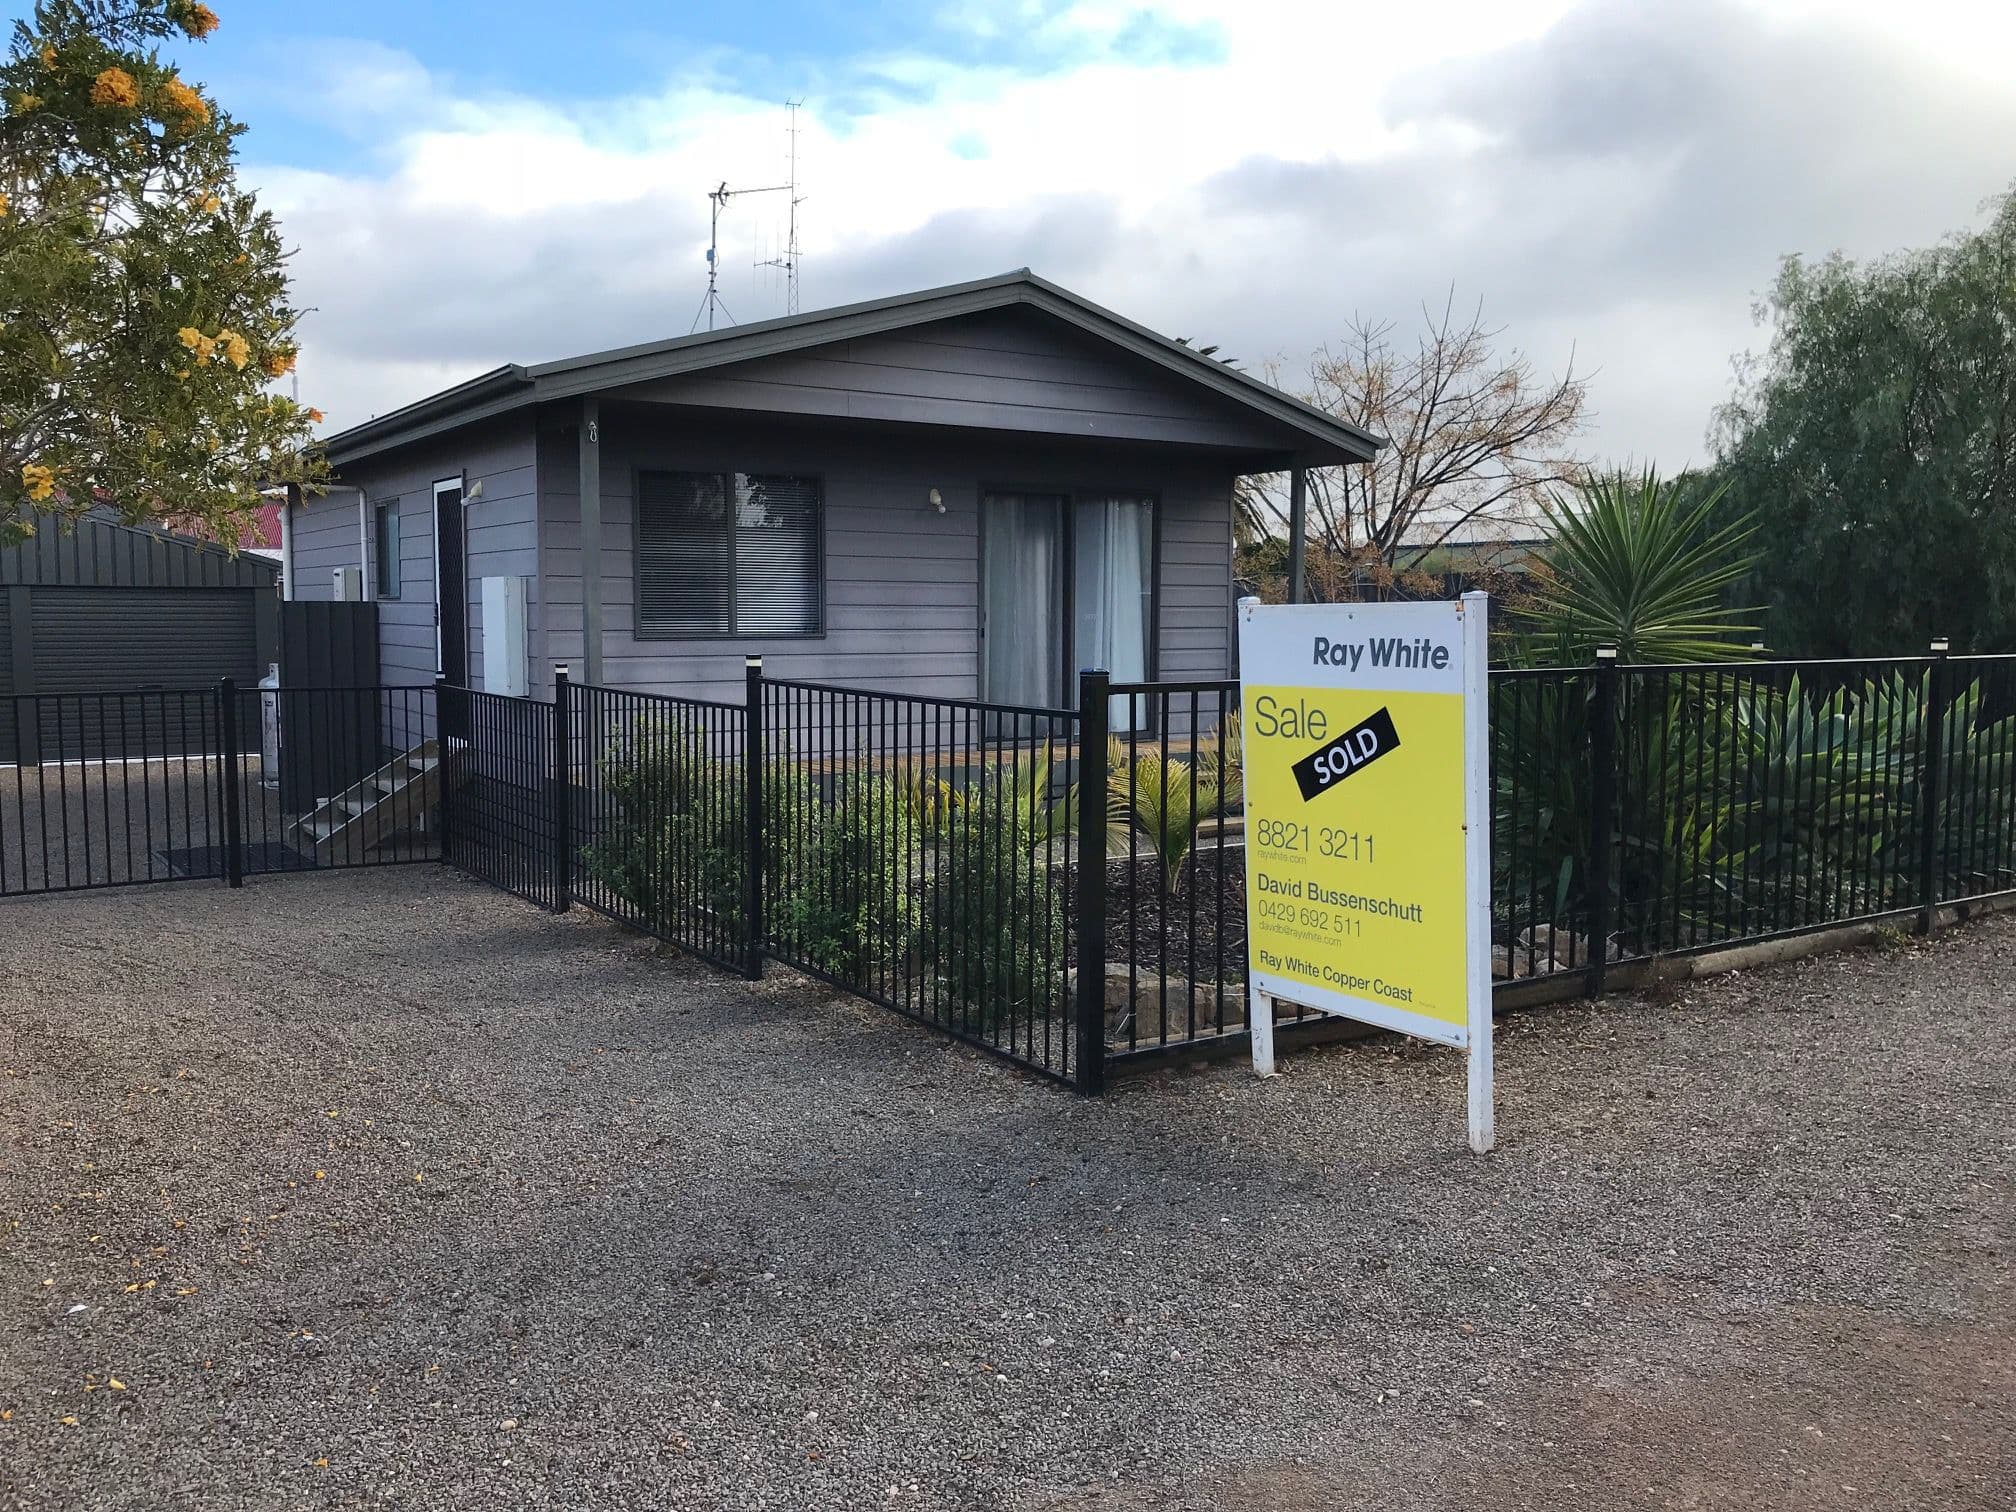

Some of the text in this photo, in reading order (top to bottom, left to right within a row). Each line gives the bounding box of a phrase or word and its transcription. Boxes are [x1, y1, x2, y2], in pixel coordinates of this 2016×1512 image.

[1313, 636, 1449, 672] Ray White
[1255, 696, 1327, 740] Sale
[1313, 727, 1378, 784] SOLD
[1257, 818, 1373, 863] 8821 3211
[1257, 849, 1307, 865] raywhite.com
[1257, 873, 1423, 923] David Bussenschutt
[1258, 899, 1361, 937] 0429 692 511
[1259, 950, 1413, 1003] Ray White Copper Coast
